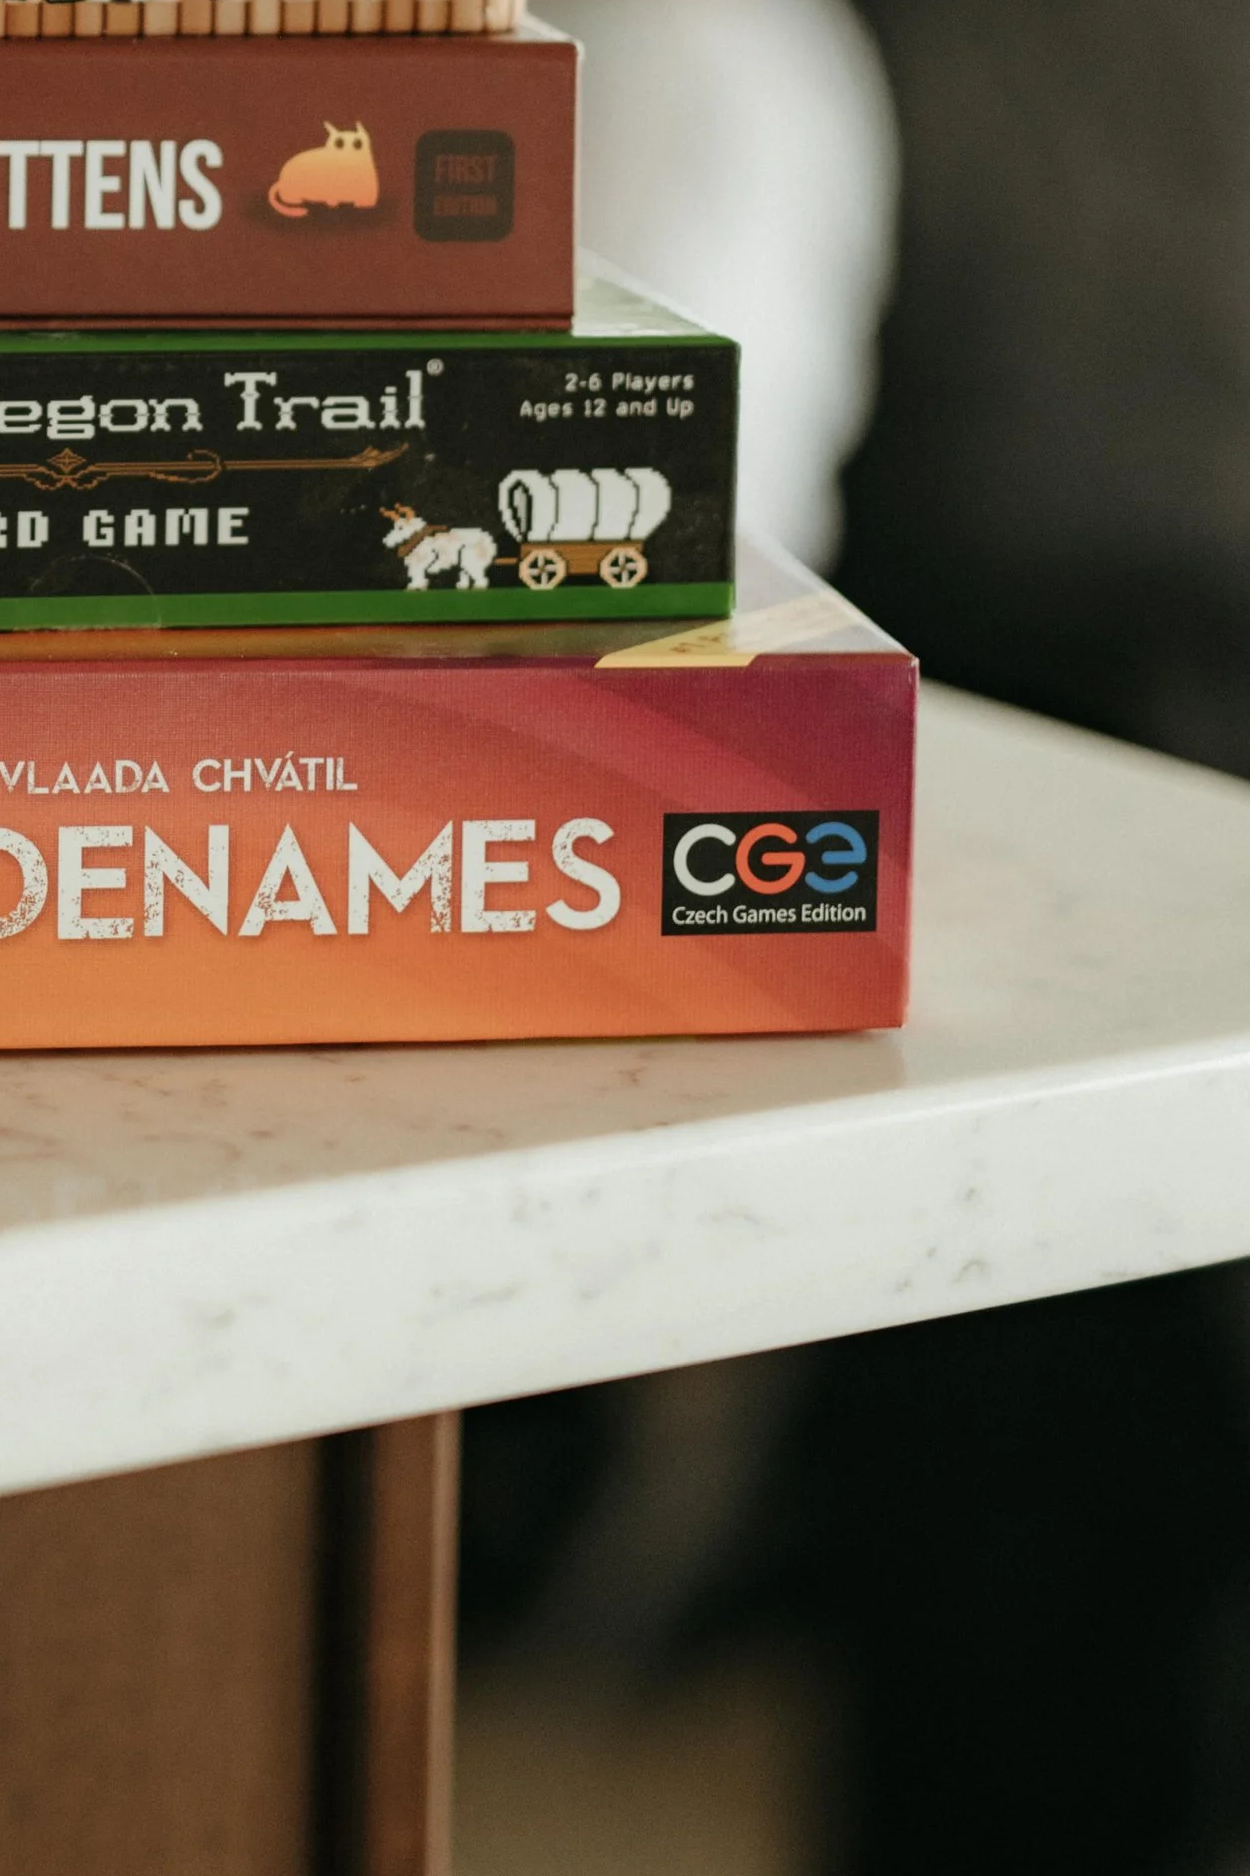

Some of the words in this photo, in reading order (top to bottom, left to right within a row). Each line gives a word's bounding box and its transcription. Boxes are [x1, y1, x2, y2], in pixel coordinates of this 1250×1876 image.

[435, 154, 497, 183] FIRST
[565, 373, 602, 392] 2-6
[612, 373, 694, 395] Players
[520, 399, 573, 422] Ages
[584, 398, 607, 417] 12
[616, 398, 657, 417] and
[667, 397, 694, 419] Up
[82, 506, 250, 548] GAME
[192, 751, 358, 794] CHVÁTIL
[672, 906, 728, 925] Czech
[732, 905, 796, 924] Games
[801, 902, 866, 922] Edition
